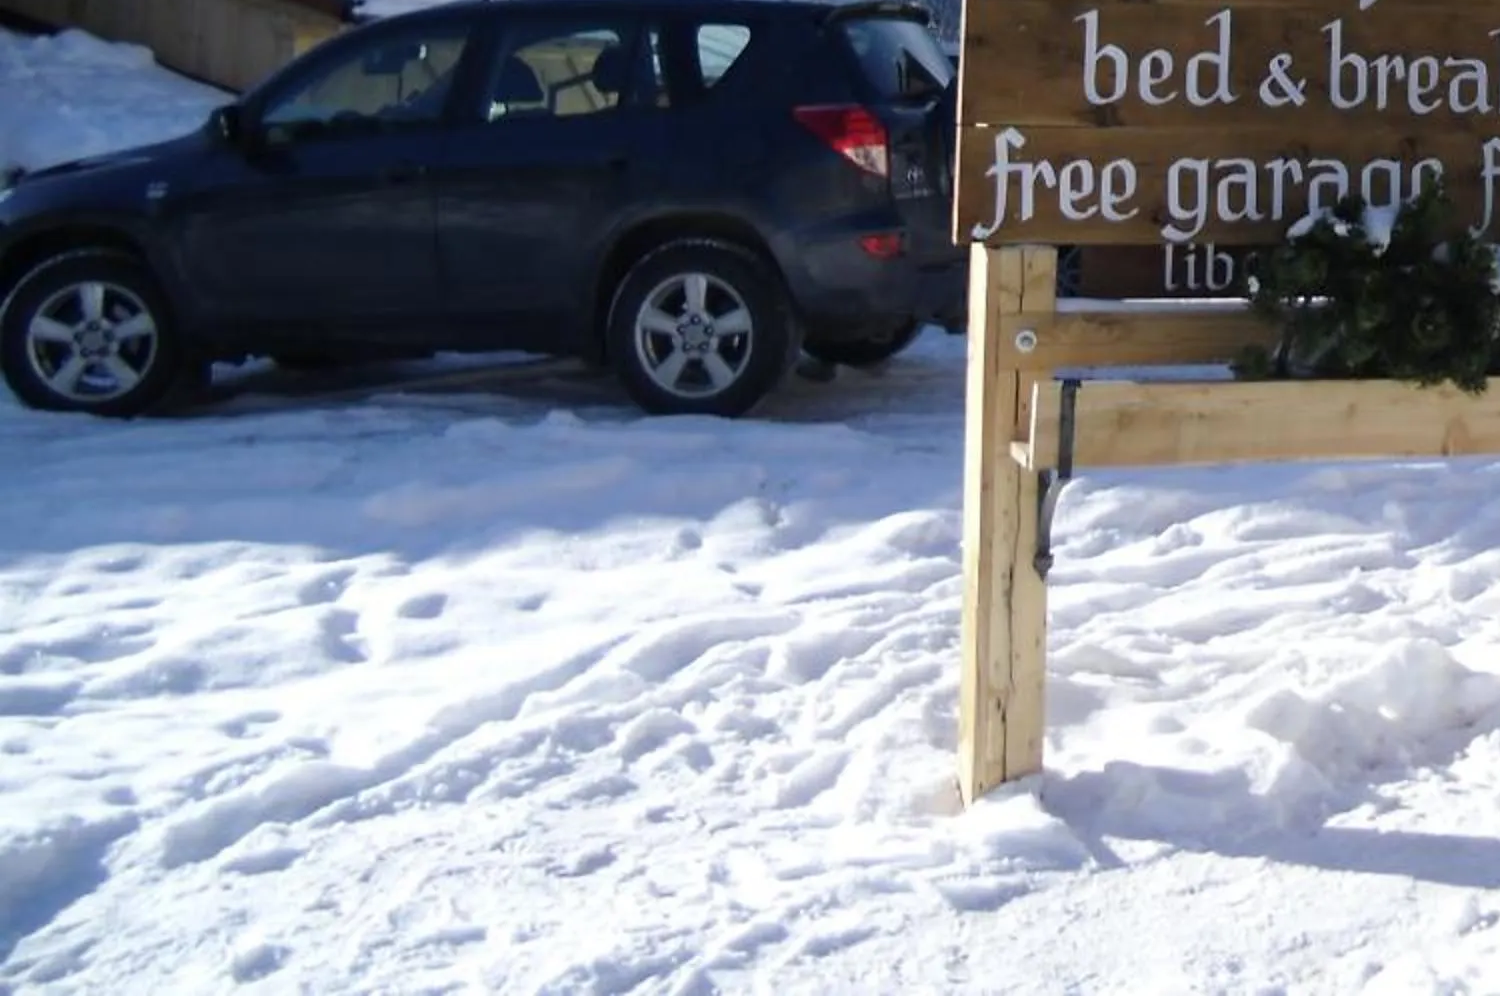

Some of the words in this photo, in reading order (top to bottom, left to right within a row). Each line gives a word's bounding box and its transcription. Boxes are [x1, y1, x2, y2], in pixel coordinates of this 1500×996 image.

[1073, 8, 1238, 107] bed
[1259, 52, 1306, 107] &
[970, 126, 1140, 239] free
[1164, 243, 1250, 291] lib
